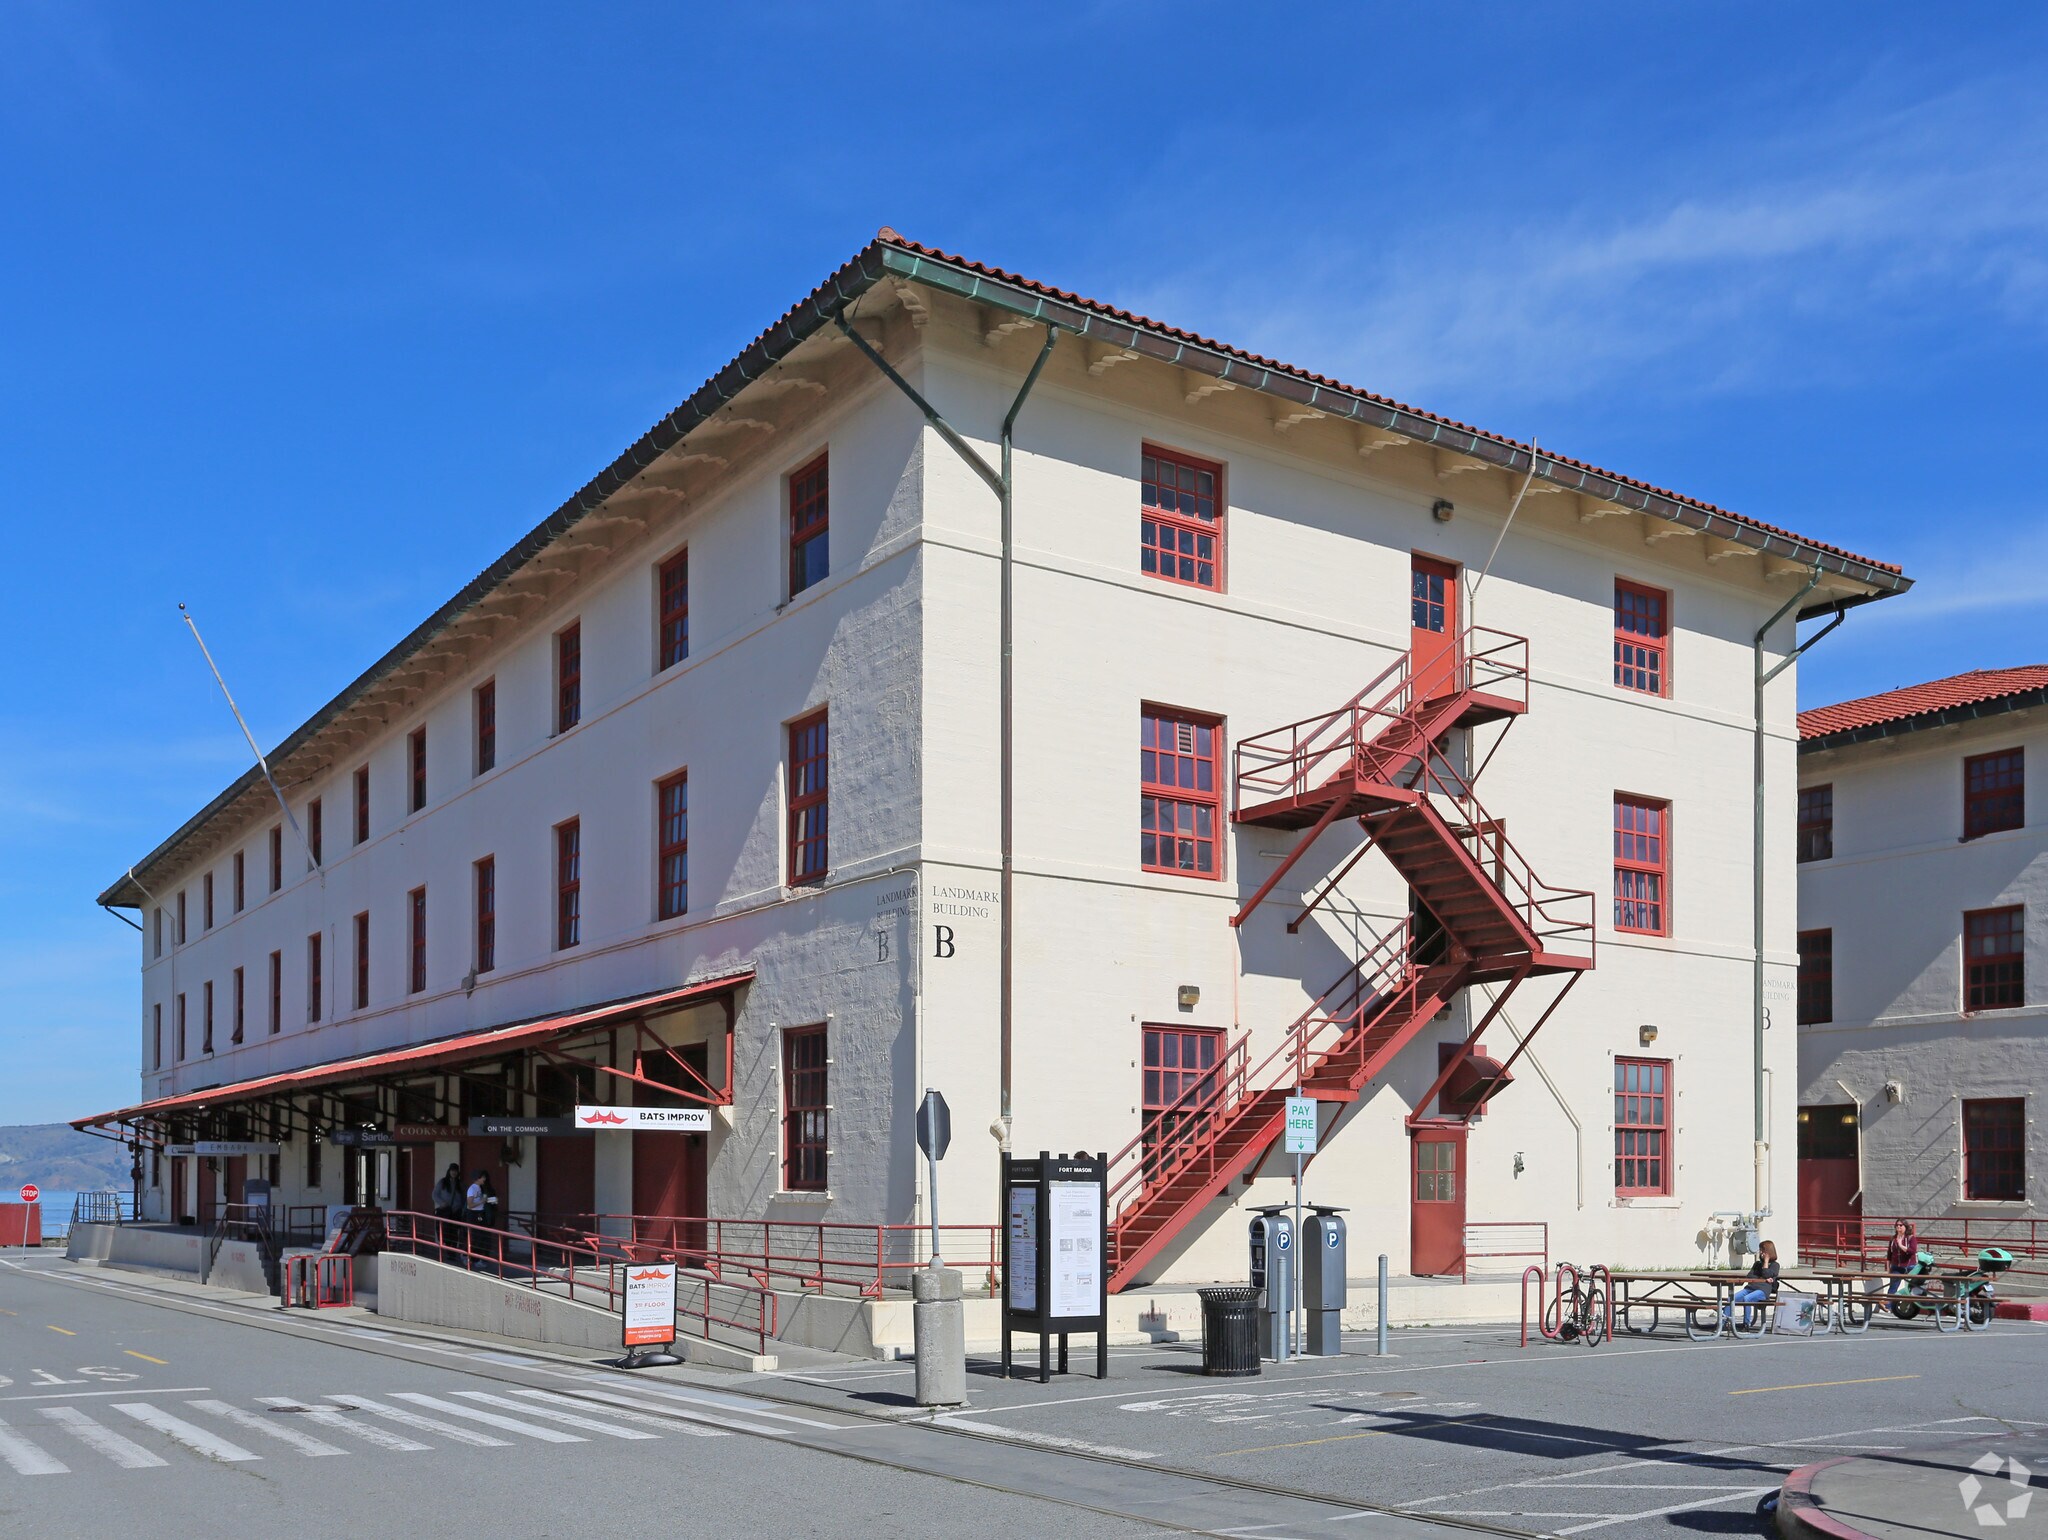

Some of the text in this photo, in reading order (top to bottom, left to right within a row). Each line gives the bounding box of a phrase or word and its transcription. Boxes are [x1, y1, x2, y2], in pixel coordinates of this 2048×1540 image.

[876, 887, 918, 906] LANDMARK
[933, 886, 1000, 903] LANDMARK
[876, 905, 910, 922] BUILDING
[933, 903, 989, 918] BUILDING
[877, 931, 889, 962] B
[932, 924, 955, 958] B
[1763, 979, 1795, 990] ANDMARK
[1763, 991, 1790, 1001] UILDING
[1291, 1105, 1310, 1116] PAY
[640, 1112, 704, 1122] BATS IMPROV
[514, 1125, 548, 1133] COMMONS
[1288, 1119, 1314, 1129] HERE
[400, 1127, 467, 1136] COOKS & CO
[210, 1143, 248, 1151] EMBARK
[21, 1189, 38, 1198] STOP
